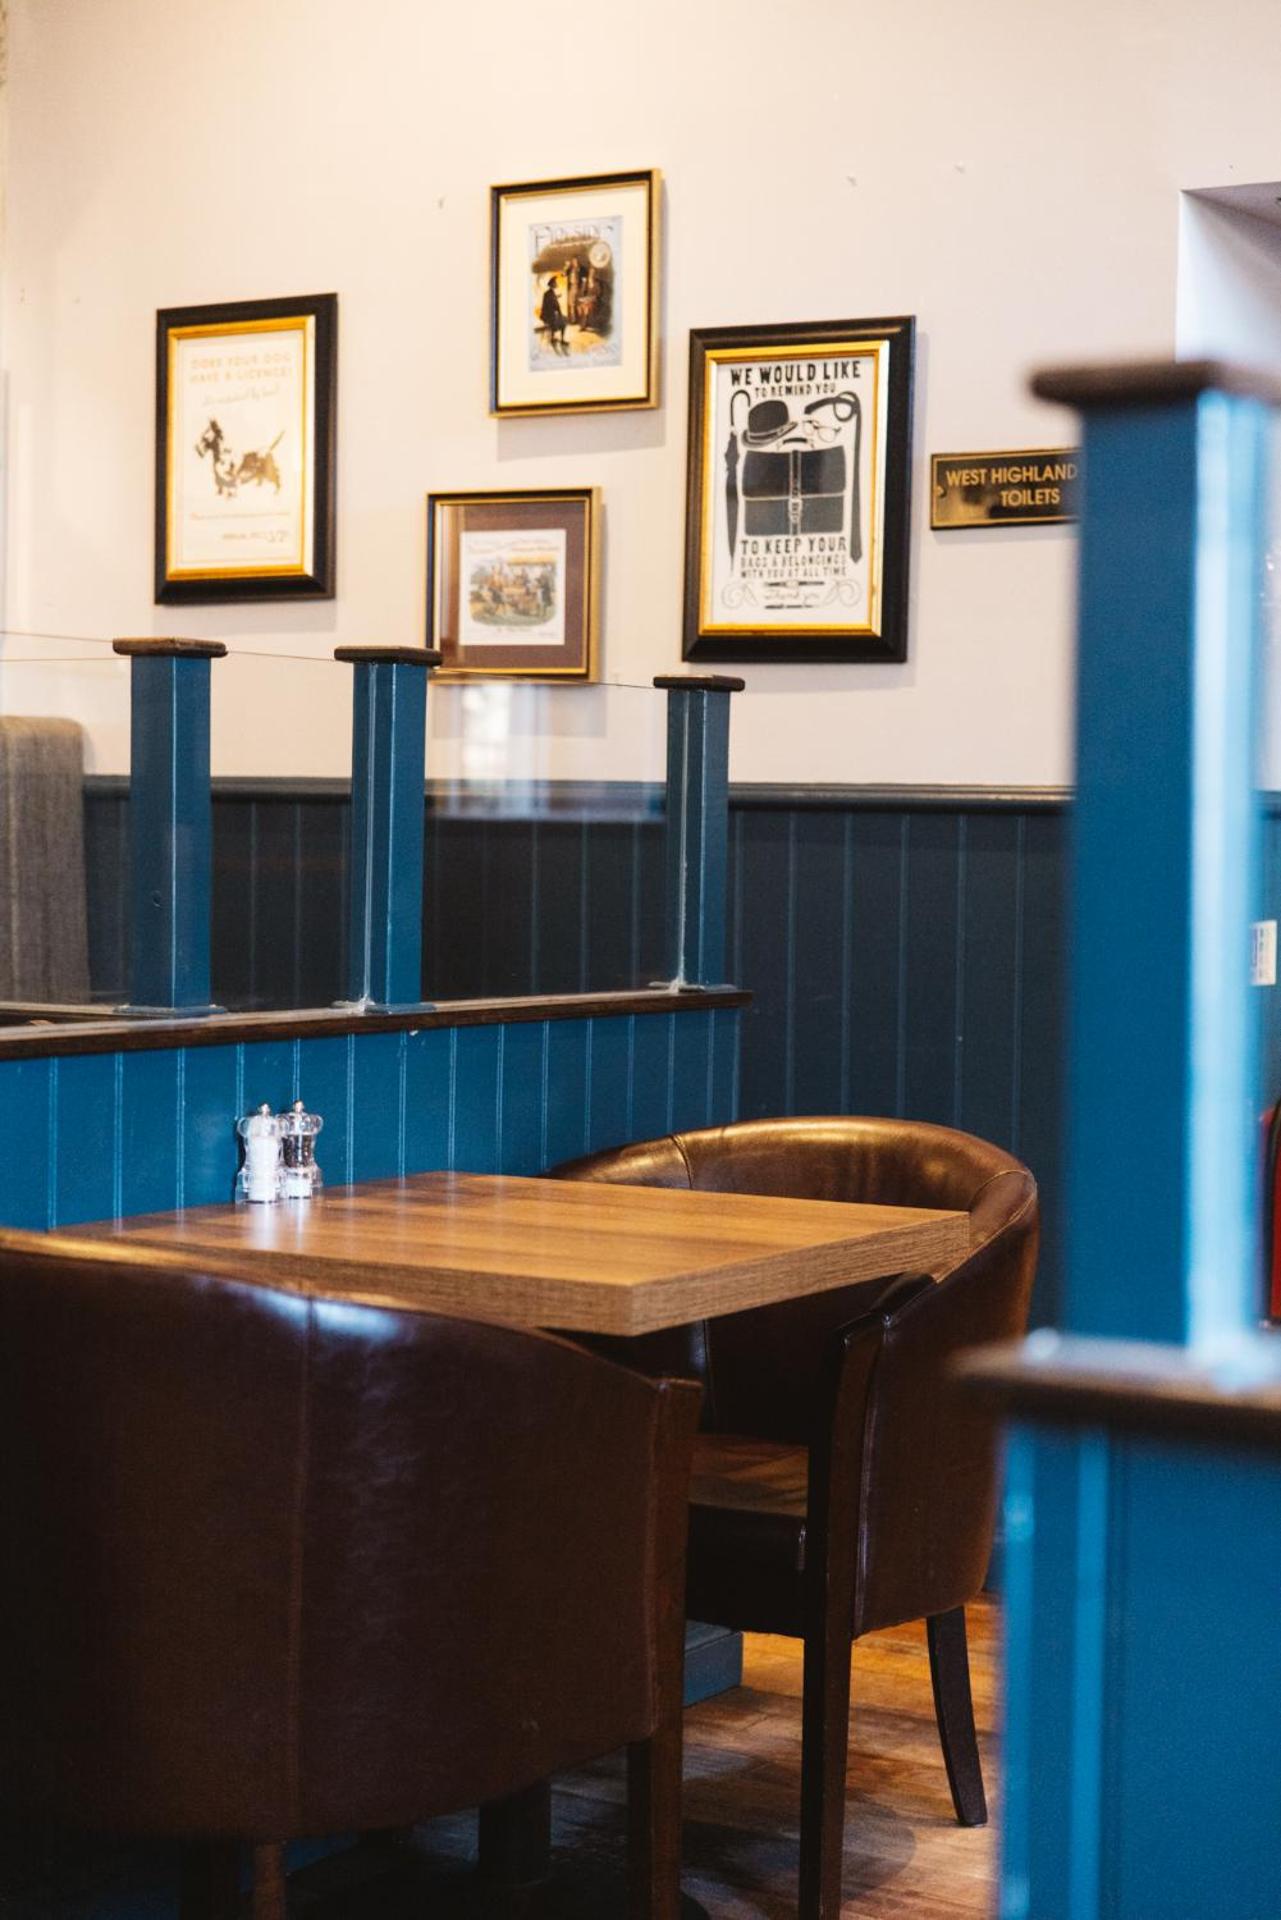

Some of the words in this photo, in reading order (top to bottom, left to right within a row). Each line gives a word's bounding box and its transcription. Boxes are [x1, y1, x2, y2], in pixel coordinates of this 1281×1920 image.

[730, 367, 752, 386] WE
[760, 363, 816, 385] WOULD
[823, 360, 861, 380] LIKE
[946, 468, 987, 486] WEST
[991, 463, 1078, 483] HIGHLAND
[1001, 488, 1061, 507] TOILETS
[741, 539, 759, 555] TO
[765, 537, 801, 554] KEEP
[808, 536, 846, 553] YOUR
